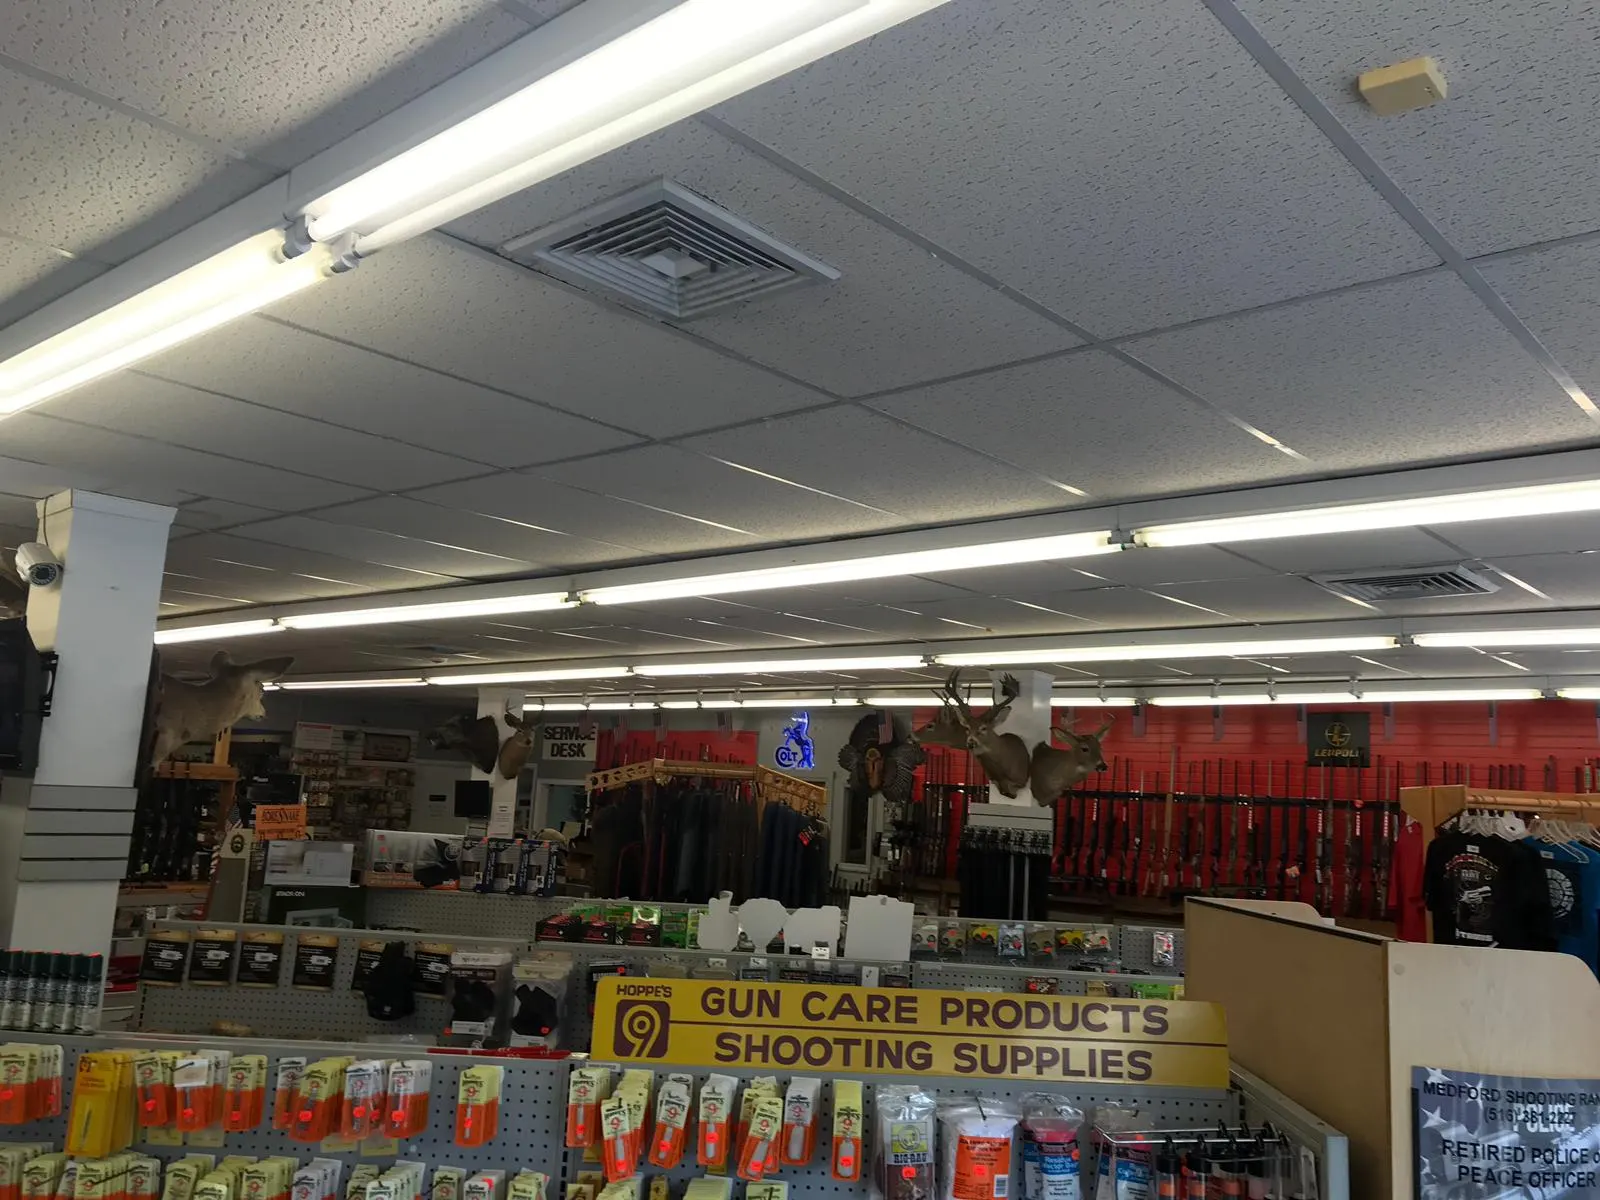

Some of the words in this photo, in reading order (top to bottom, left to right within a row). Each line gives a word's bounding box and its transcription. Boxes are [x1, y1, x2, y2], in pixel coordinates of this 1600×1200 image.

[551, 743, 586, 757] DESK
[775, 747, 798, 768] COLT
[616, 984, 672, 998] HOPPE'S
[701, 987, 781, 1019] GUN
[802, 992, 918, 1024] CARE
[941, 996, 1168, 1036] PRODUCTS
[715, 1032, 933, 1071] SHOOTING
[954, 1042, 1153, 1081] SUPPLIES
[1423, 1081, 1500, 1102] MEDFORD
[1506, 1091, 1576, 1106] SHOOTING
[1484, 1106, 1518, 1123] (516)
[1442, 1139, 1525, 1163] RETIRED
[1531, 1148, 1589, 1164] POLICE
[1458, 1165, 1522, 1187] PEACE
[1528, 1171, 1597, 1188] OFFICER
